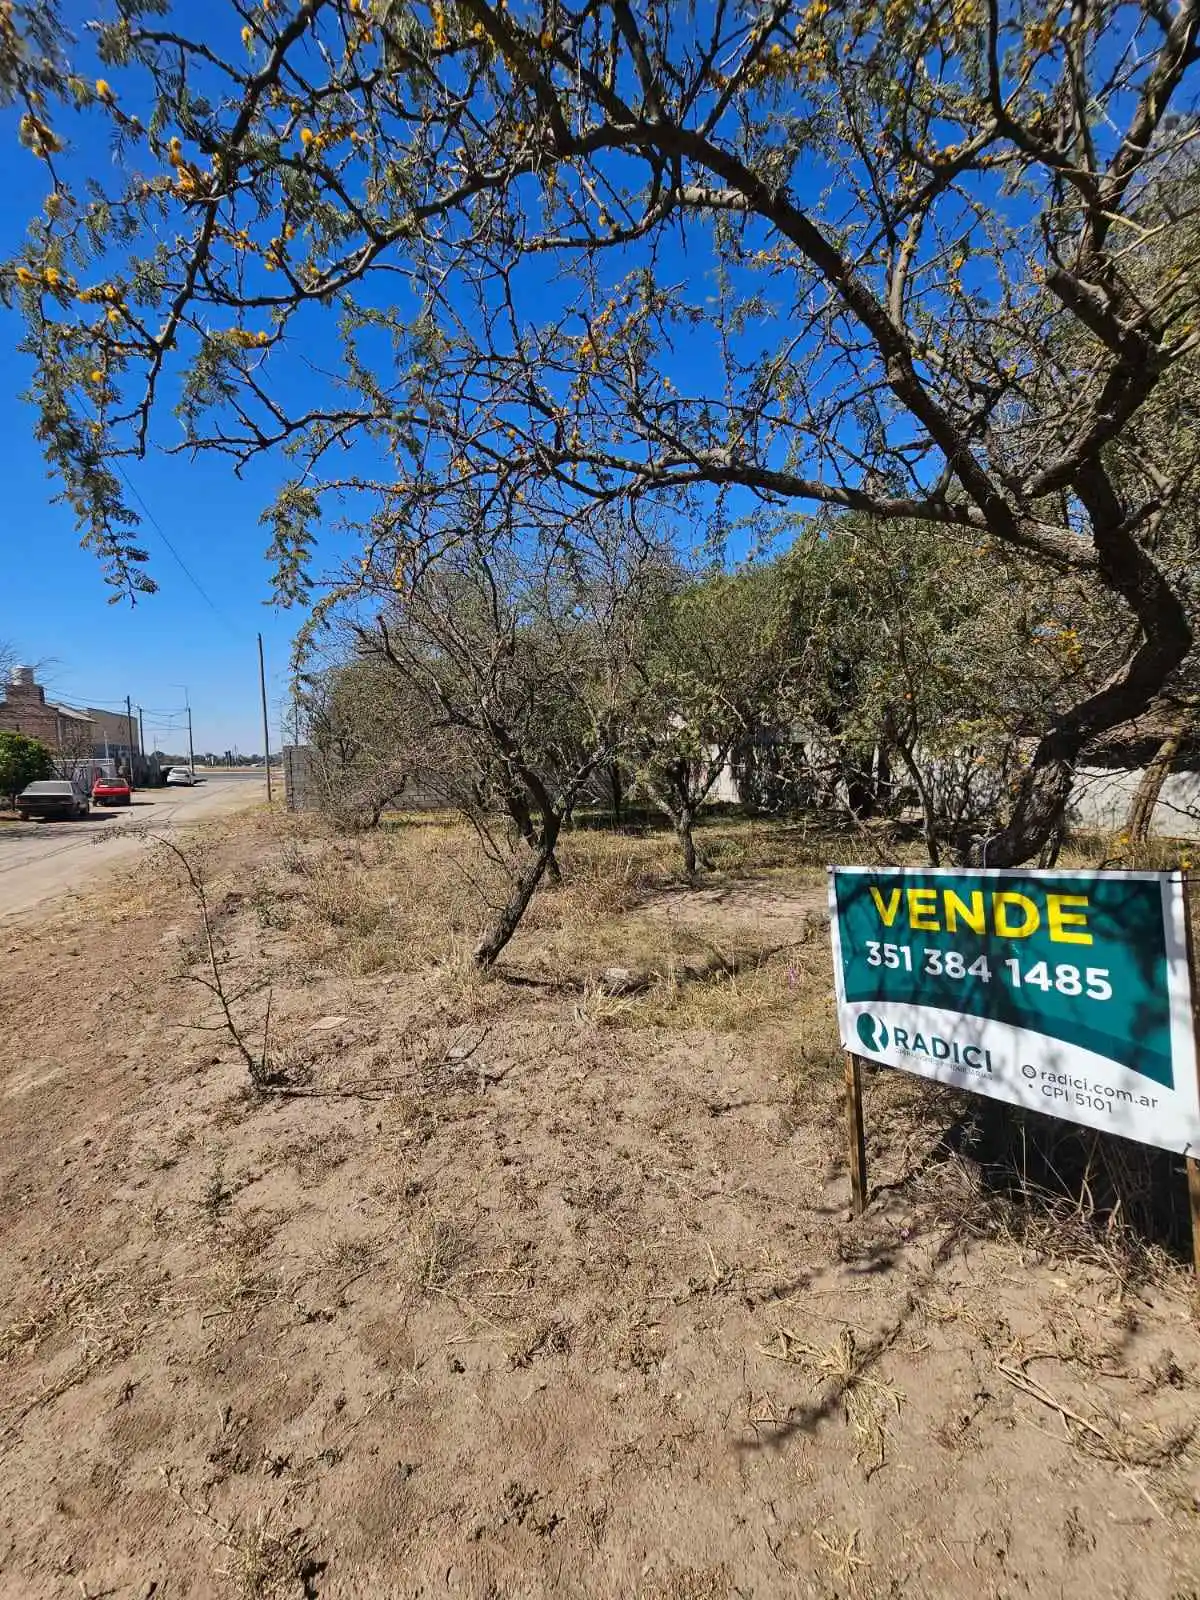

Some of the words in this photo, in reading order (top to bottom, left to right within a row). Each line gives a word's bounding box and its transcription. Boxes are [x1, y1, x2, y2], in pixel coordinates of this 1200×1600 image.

[870, 886, 1093, 945] VENDE
[865, 940, 912, 972] 351
[923, 948, 992, 983] 384
[1005, 958, 1113, 1001] 1485
[893, 1026, 993, 1073] RADICI
[1040, 1070, 1158, 1108] radici.com.ar
[1041, 1085, 1069, 1102] CPI
[1075, 1093, 1113, 1113] 5101
